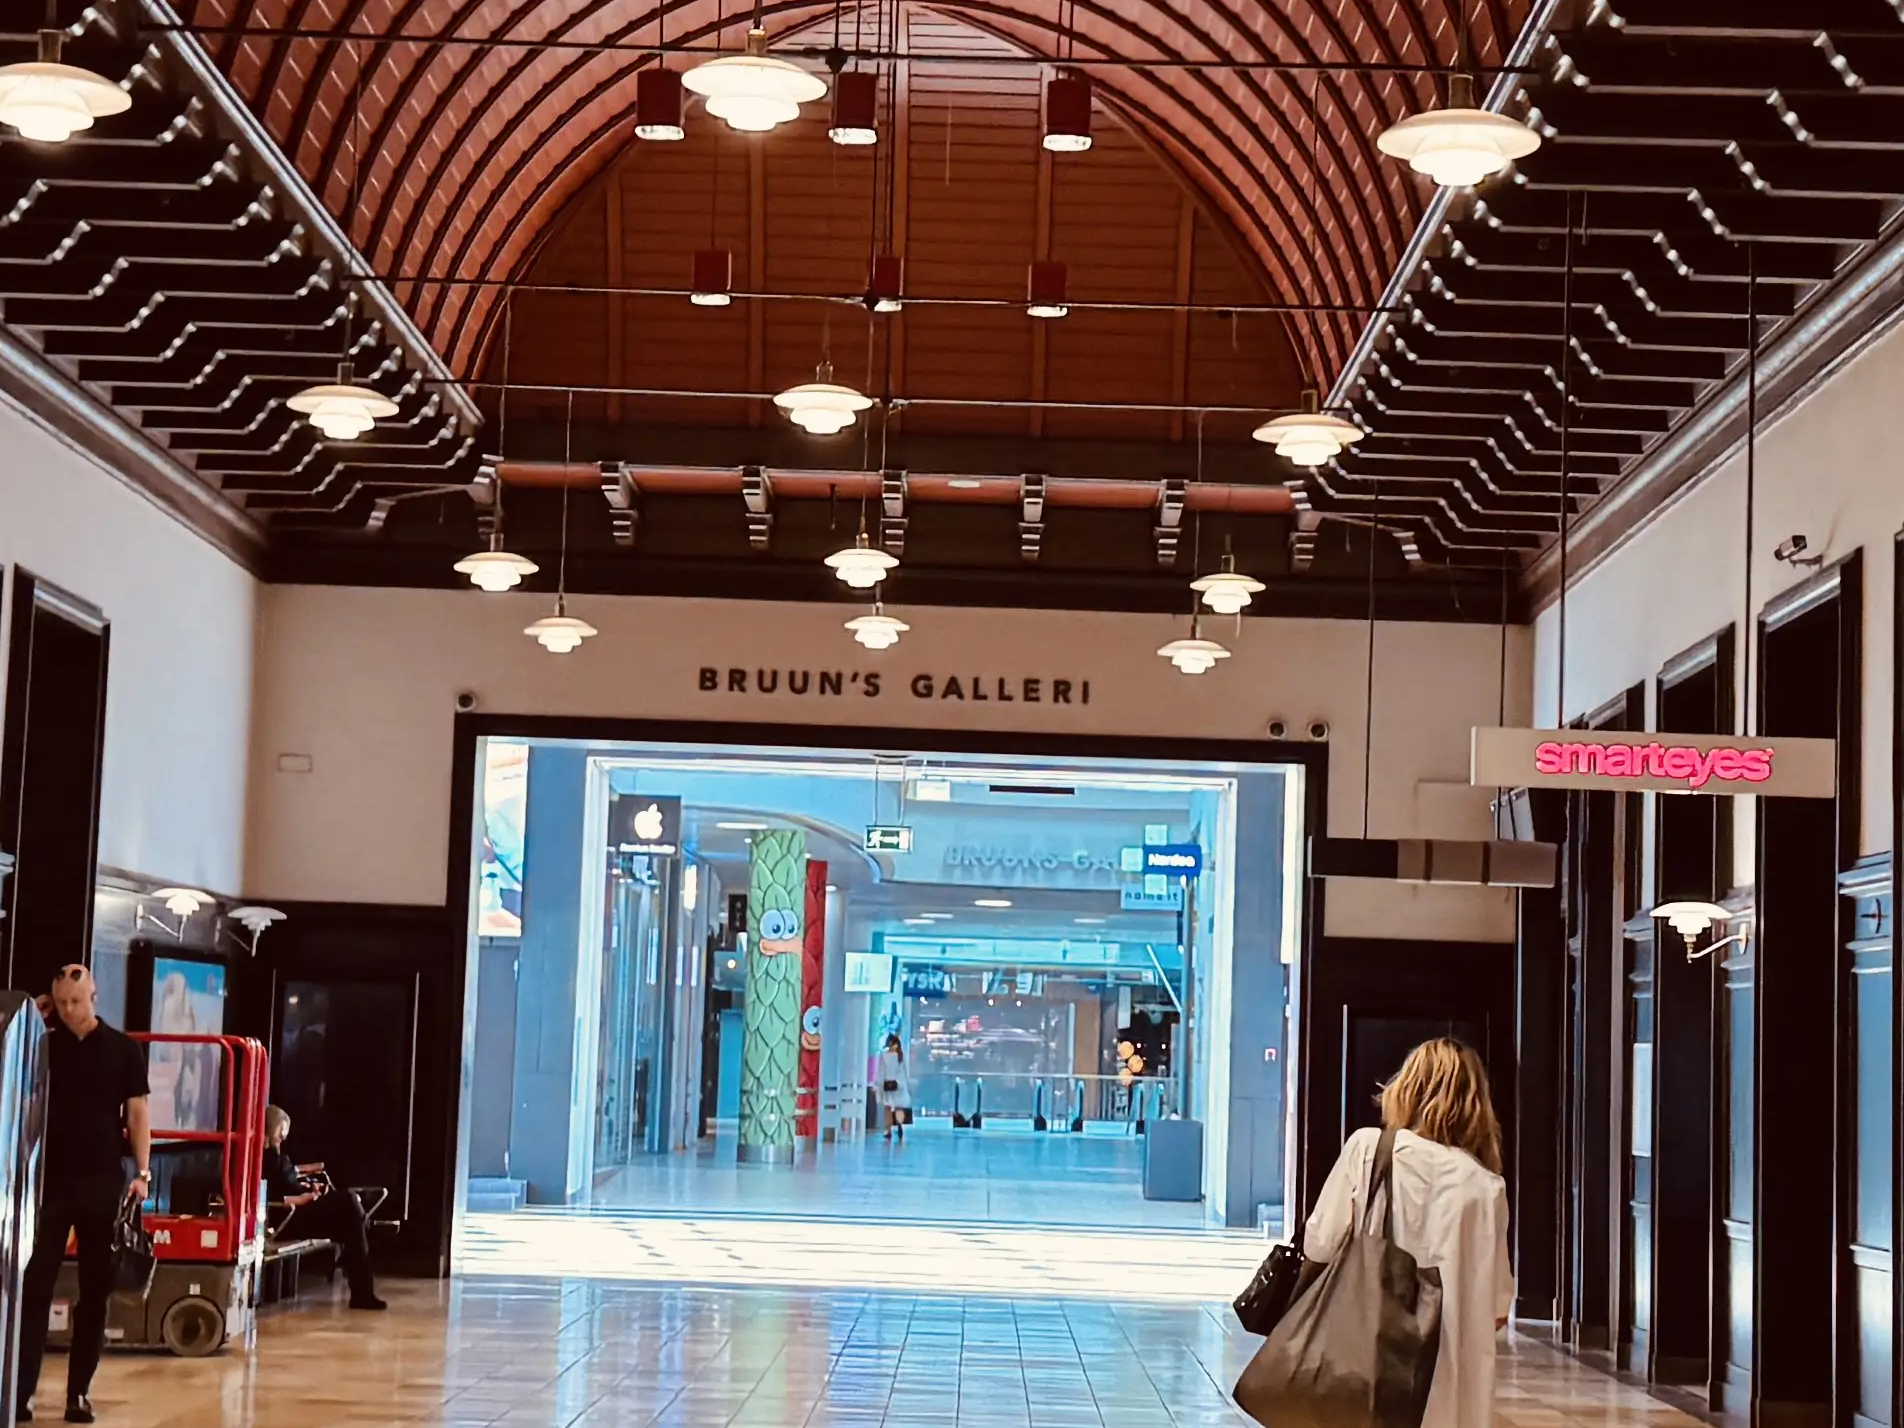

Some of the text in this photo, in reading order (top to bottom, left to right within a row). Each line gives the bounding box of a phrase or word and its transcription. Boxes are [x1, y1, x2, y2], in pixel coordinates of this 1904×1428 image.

[698, 667, 1090, 705] BRUUN'S GALLERI
[1535, 742, 1773, 788] smarteyes
